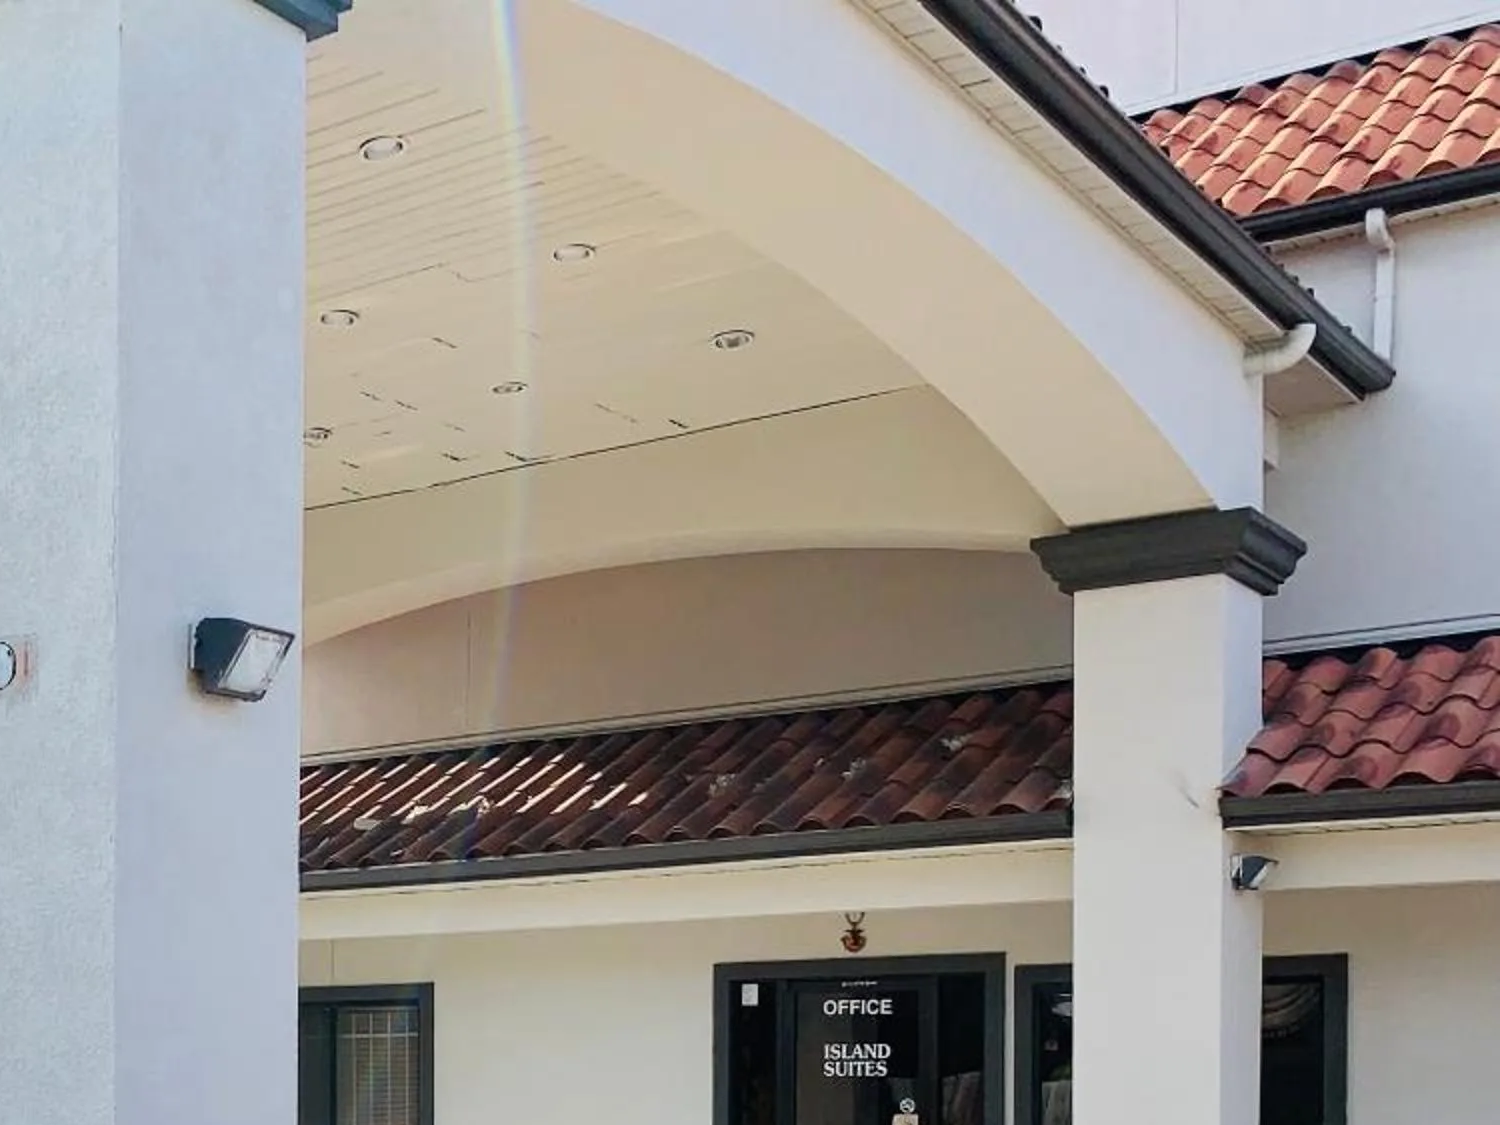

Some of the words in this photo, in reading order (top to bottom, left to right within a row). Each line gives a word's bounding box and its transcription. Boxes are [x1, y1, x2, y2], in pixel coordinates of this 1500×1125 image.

[823, 999, 893, 1015] OFFICE
[823, 1043, 891, 1060] ISLAND
[823, 1061, 888, 1077] SUITES
